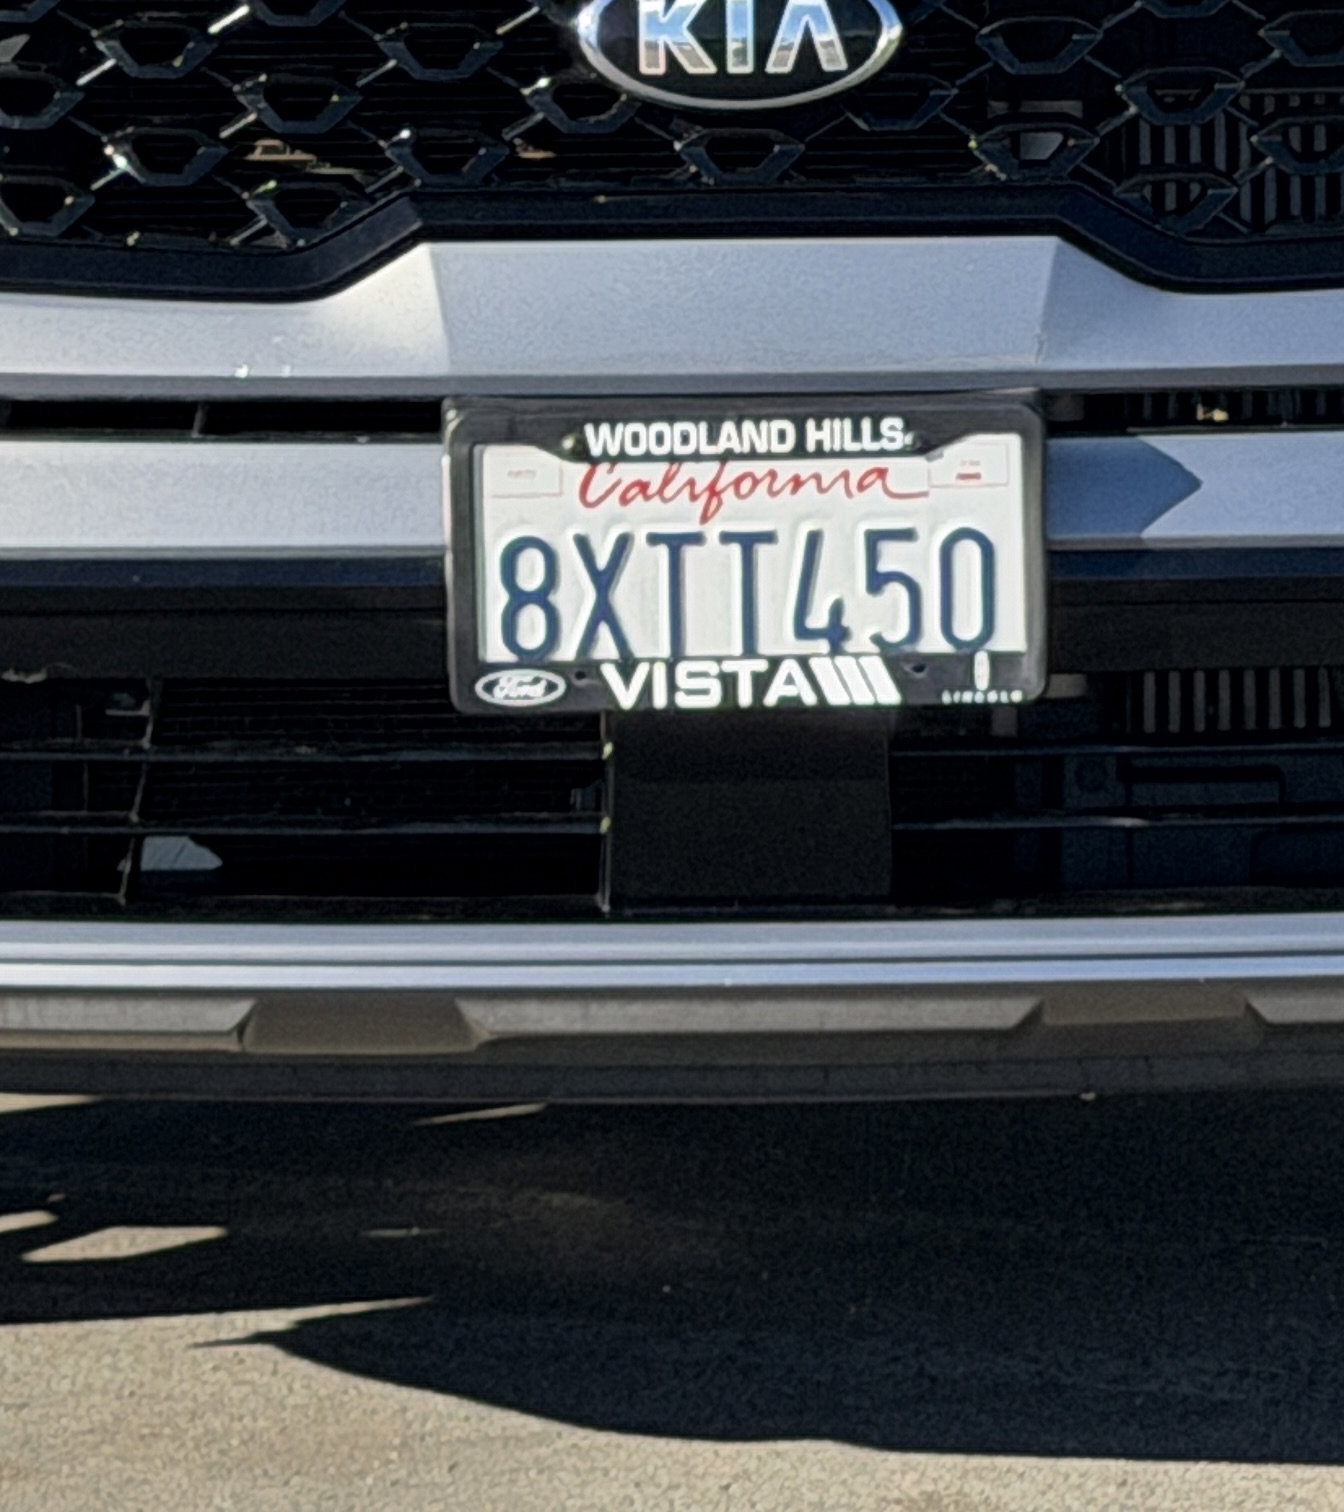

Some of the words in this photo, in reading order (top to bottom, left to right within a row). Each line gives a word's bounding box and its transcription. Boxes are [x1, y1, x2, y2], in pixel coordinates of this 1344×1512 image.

[585, 420, 796, 457] WOODLAND
[806, 417, 905, 453] HILLS
[579, 461, 929, 525] California
[500, 526, 995, 661] 8XTT450
[600, 658, 818, 709] VISTA
